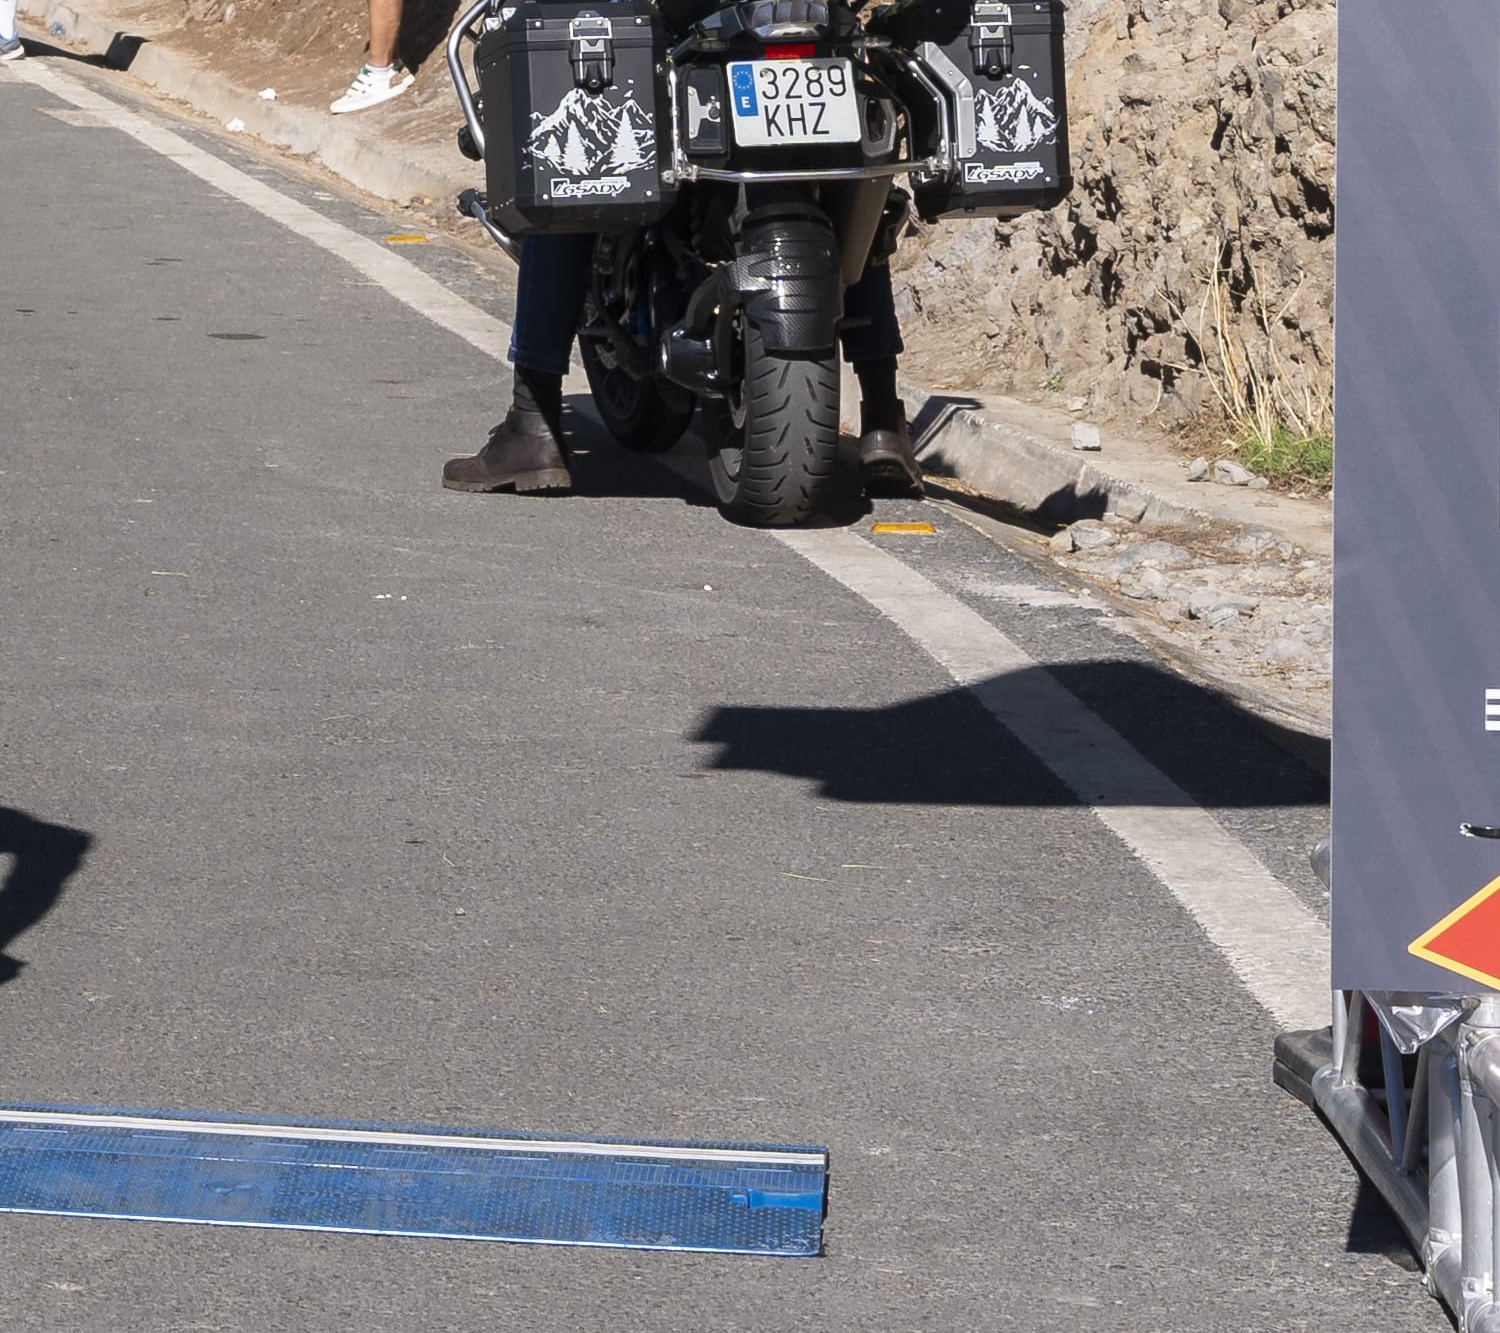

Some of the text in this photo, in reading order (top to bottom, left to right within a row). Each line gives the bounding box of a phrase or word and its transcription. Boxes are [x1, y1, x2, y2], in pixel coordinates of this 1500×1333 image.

[759, 65, 847, 100] 3289
[741, 96, 751, 109] E
[764, 102, 830, 137] KHZ
